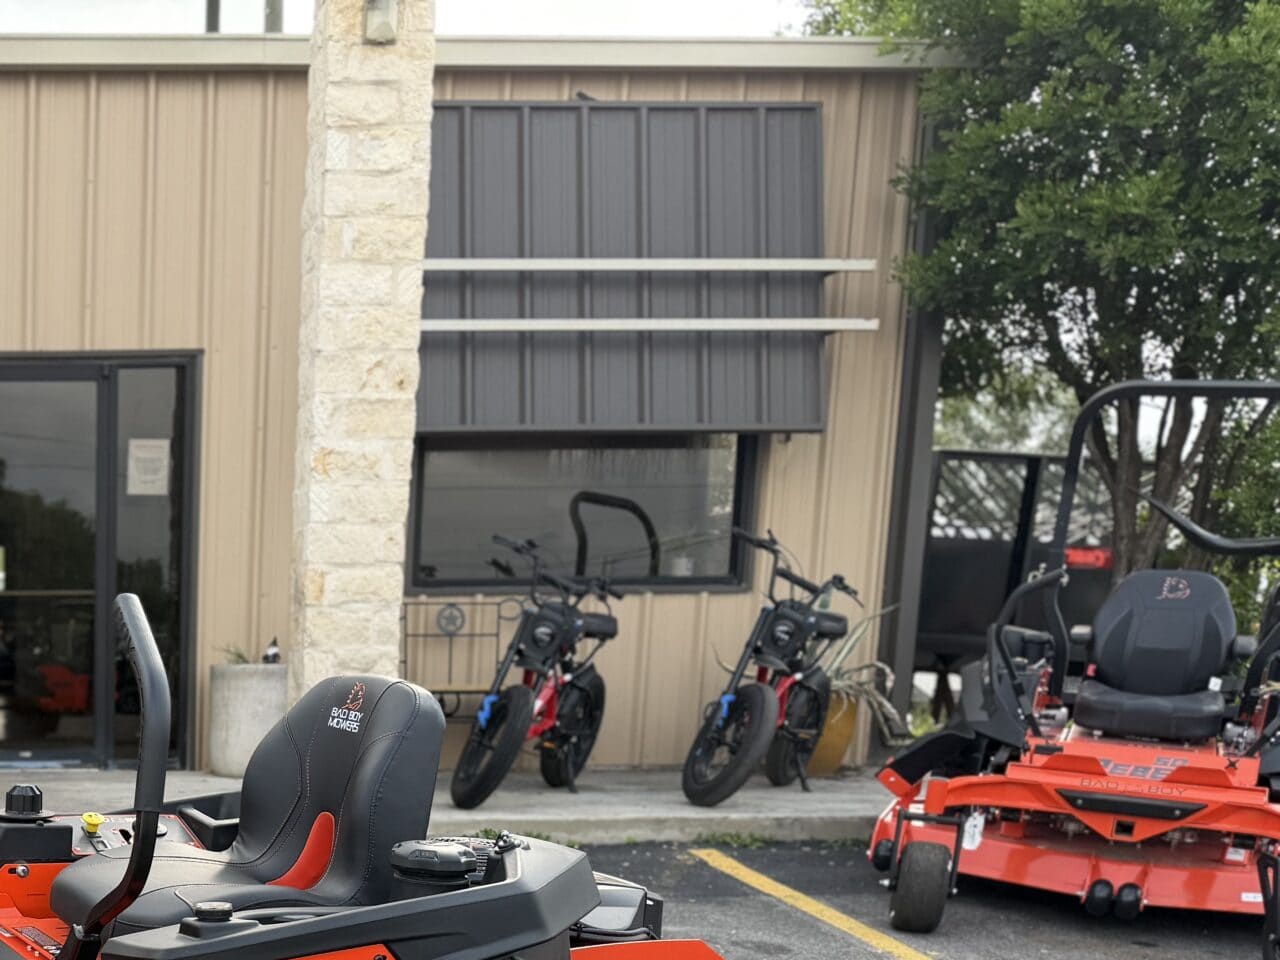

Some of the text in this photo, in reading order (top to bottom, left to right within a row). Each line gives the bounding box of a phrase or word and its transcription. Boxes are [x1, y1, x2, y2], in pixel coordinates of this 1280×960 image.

[331, 707, 364, 722] BAD BOY
[328, 717, 360, 732] MOWERS
[1099, 758, 1174, 781] EBE
[1081, 778, 1187, 797] BAD BOY
